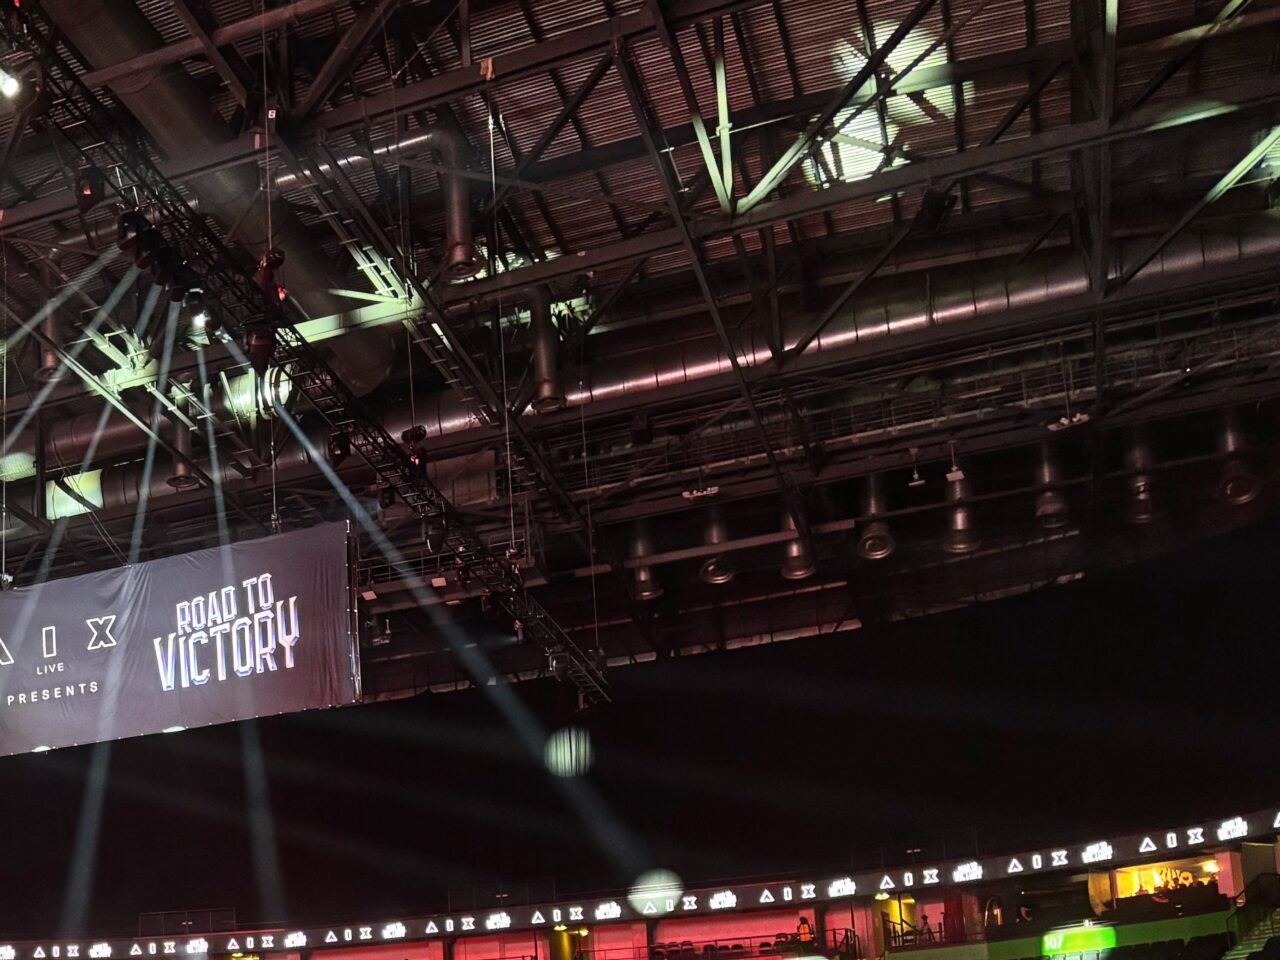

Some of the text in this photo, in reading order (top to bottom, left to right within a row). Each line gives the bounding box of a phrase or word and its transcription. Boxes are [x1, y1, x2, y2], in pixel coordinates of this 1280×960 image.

[176, 573, 274, 636] ROAD TO
[153, 596, 300, 692] VICTORY
[36, 662, 65, 676] LIVE
[7, 681, 99, 706] PRESENTS
